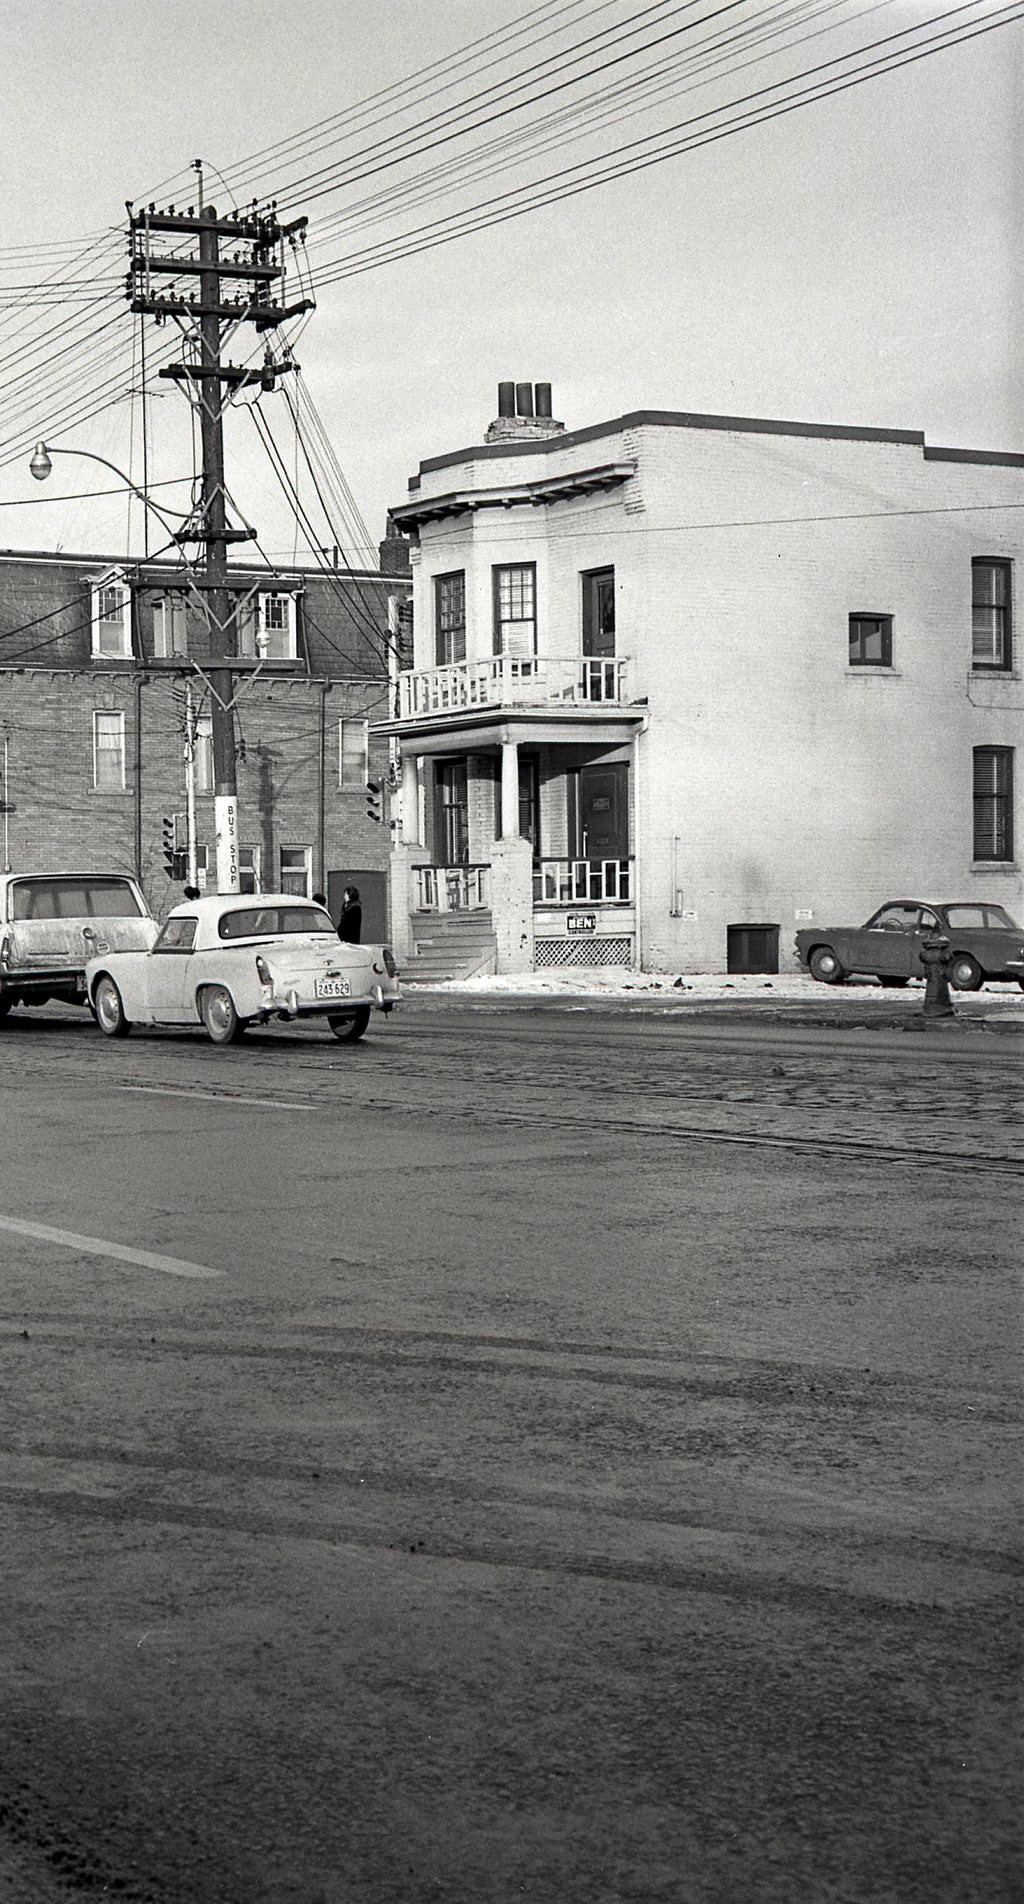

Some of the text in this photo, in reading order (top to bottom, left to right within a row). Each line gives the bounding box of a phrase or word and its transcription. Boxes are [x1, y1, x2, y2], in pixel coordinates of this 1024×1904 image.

[227, 805, 238, 885] BUS STOP
[336, 982, 350, 995] 629
